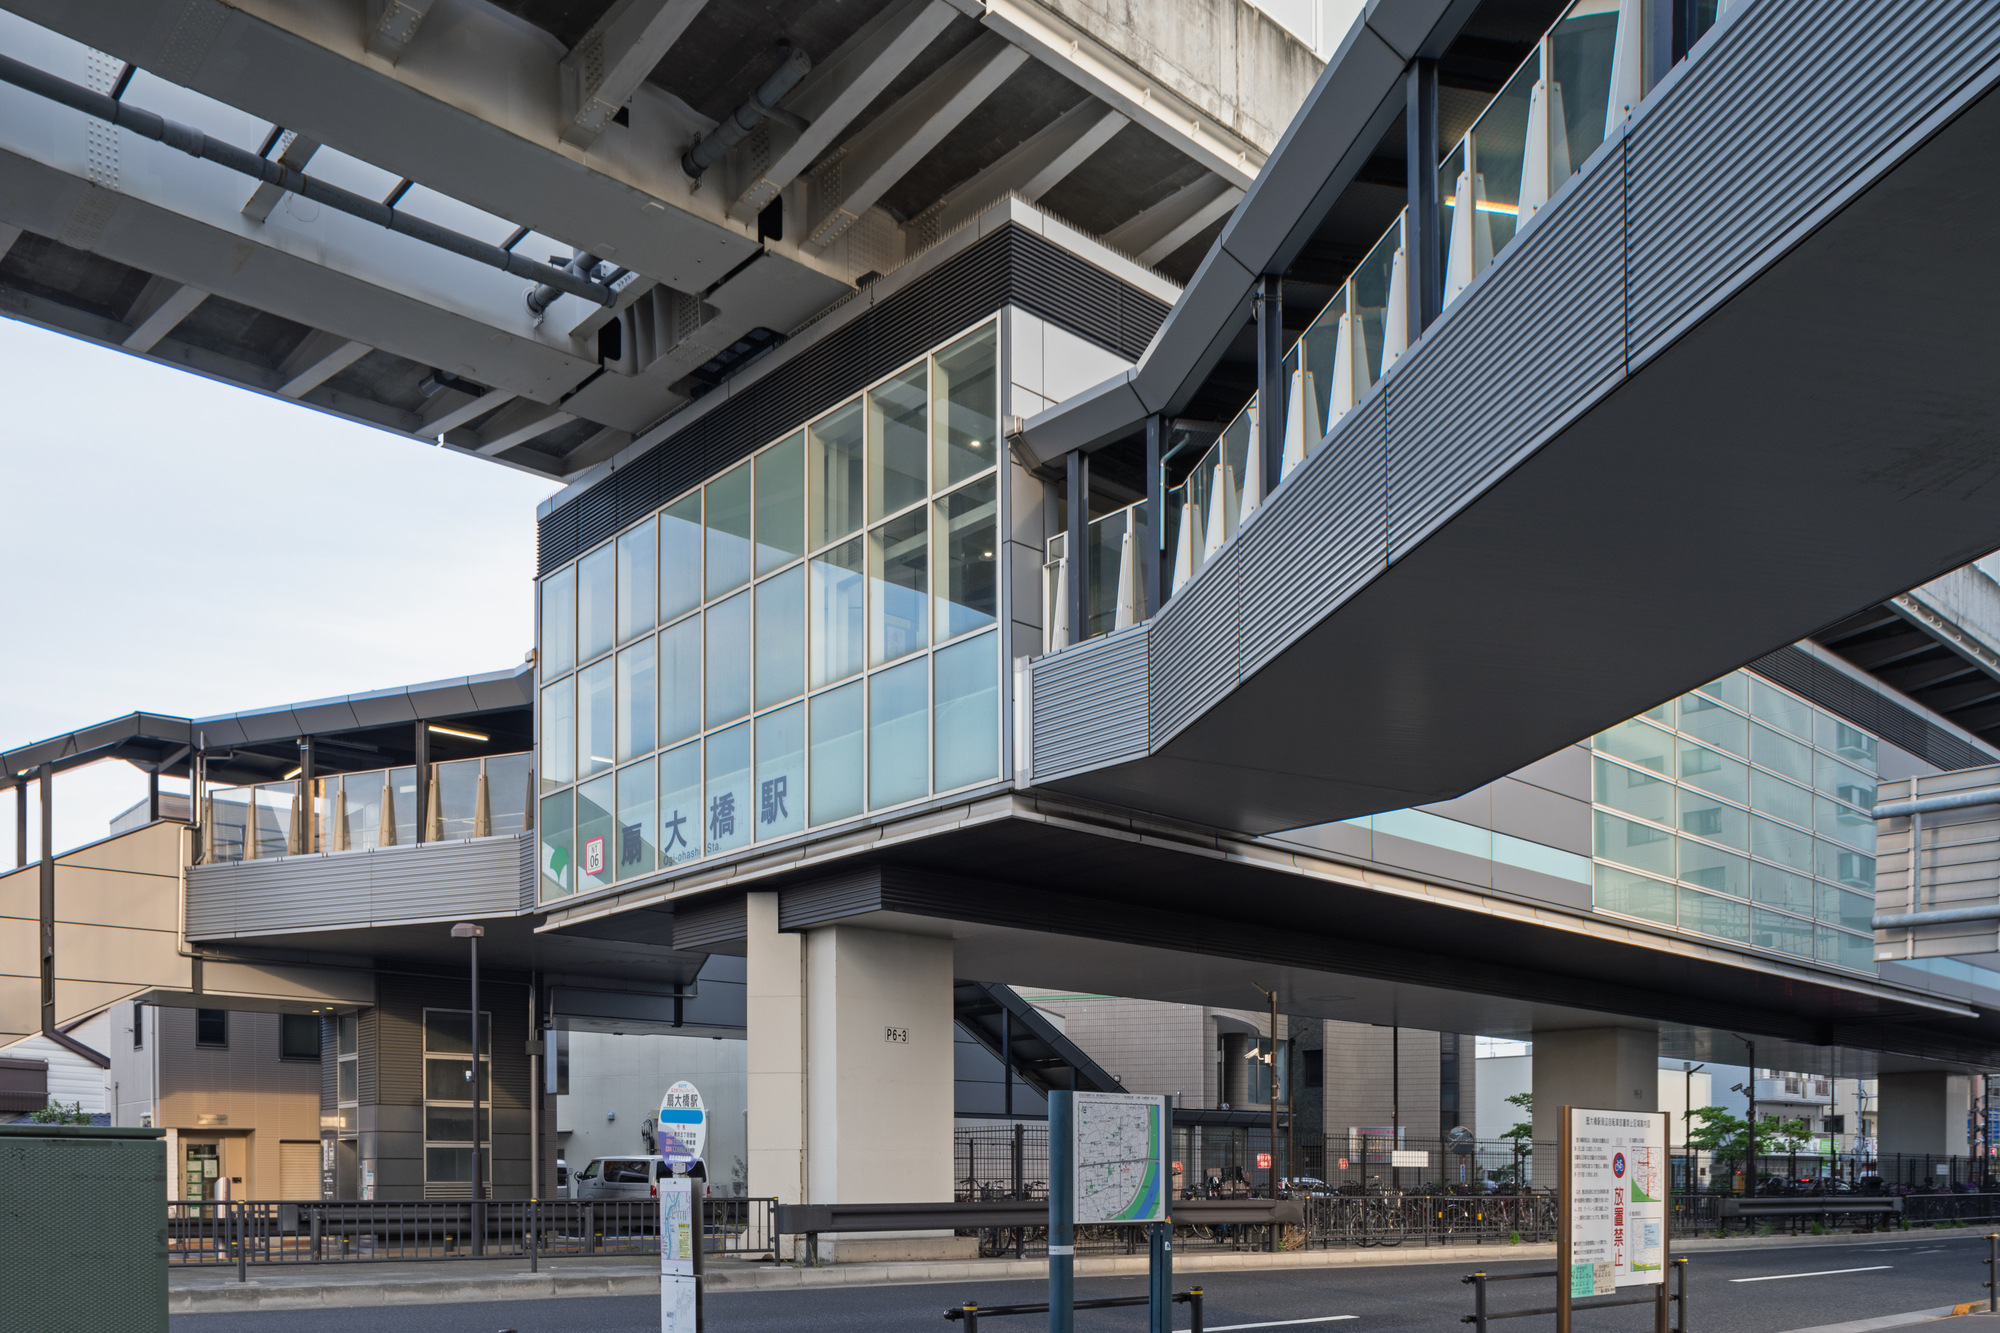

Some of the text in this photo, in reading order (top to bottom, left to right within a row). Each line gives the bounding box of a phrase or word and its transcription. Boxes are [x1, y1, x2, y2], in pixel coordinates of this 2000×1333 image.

[621, 775, 788, 866] 扇大橋駅
[590, 845, 598, 854] NT
[663, 842, 722, 866] Ogi-ohashi Sta.
[589, 852, 600, 868] 06
[887, 1028, 907, 1042] P6-3
[666, 1093, 698, 1108] 扇大橋駅
[1613, 1187, 1624, 1267] 放置禁止
